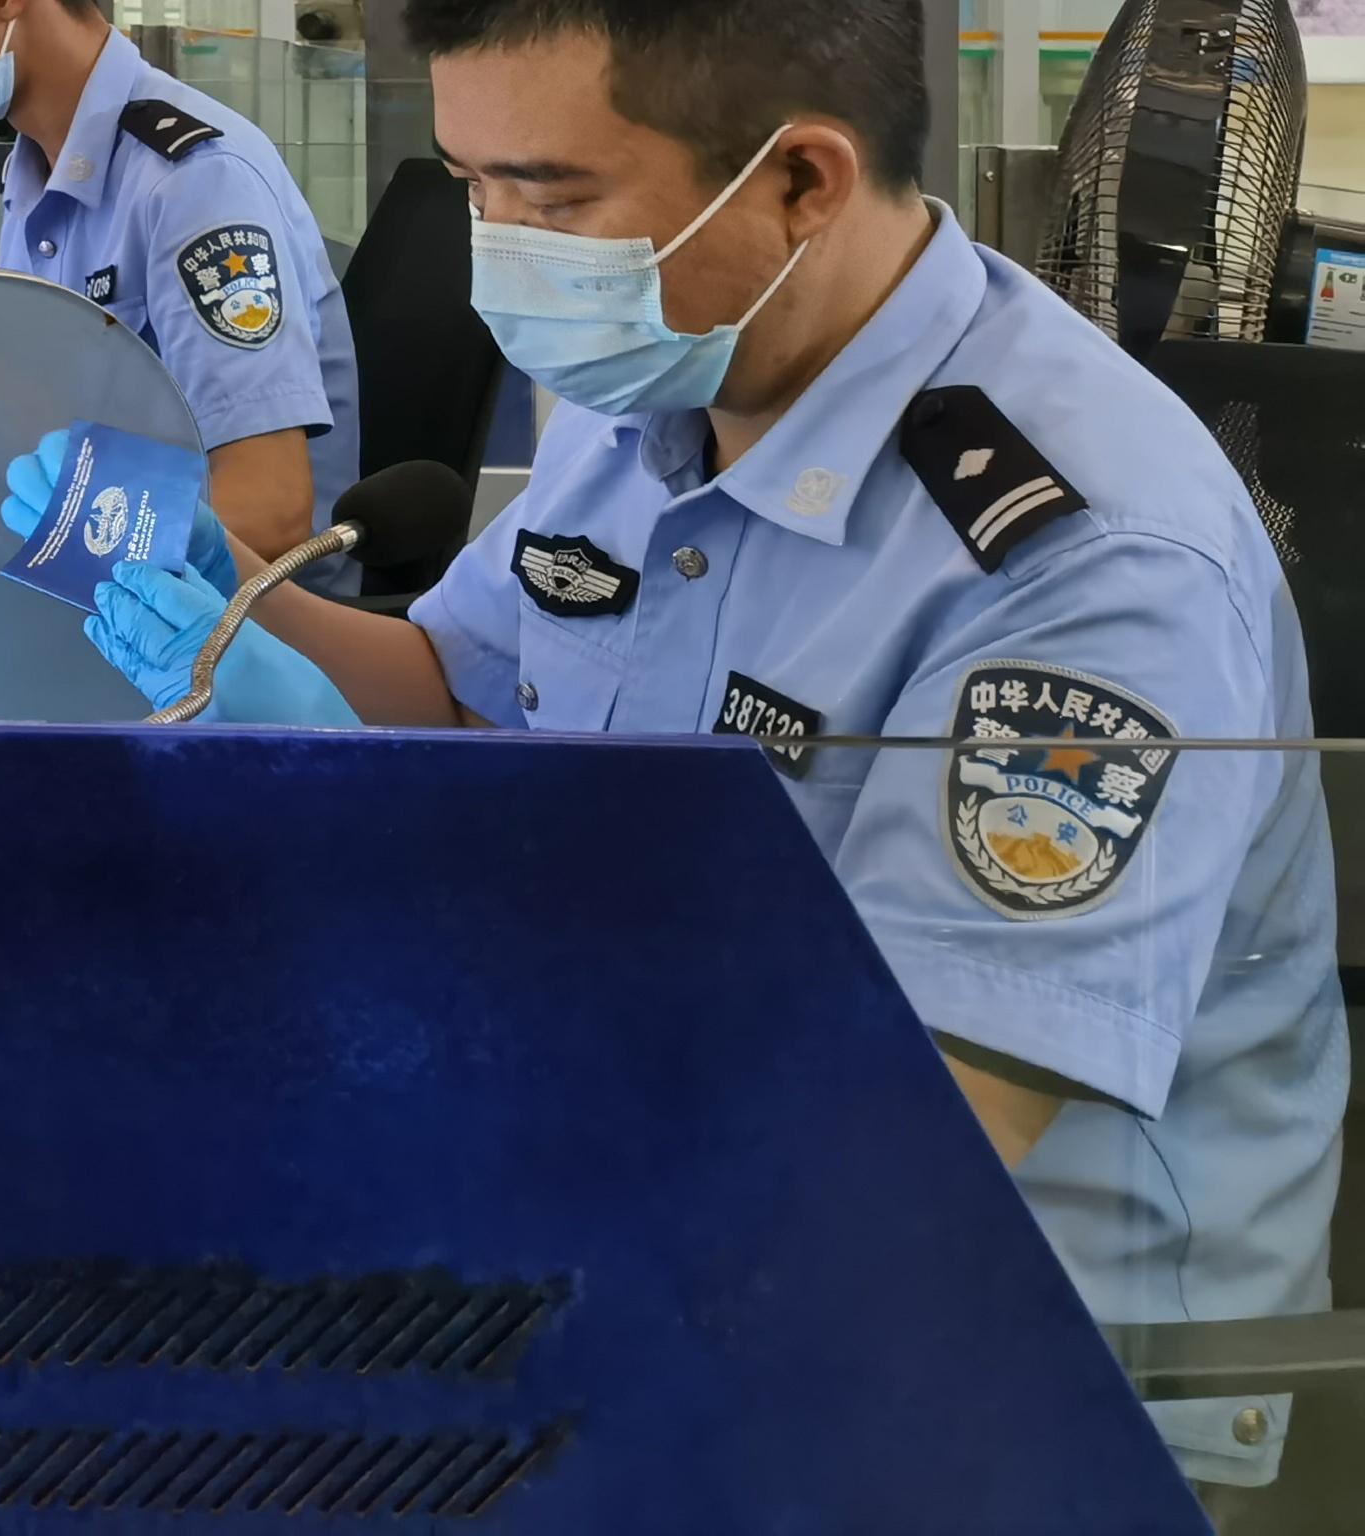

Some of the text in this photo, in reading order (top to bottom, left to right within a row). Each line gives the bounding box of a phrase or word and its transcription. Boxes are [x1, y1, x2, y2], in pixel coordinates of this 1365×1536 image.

[183, 229, 269, 272] 中华人民共和国
[222, 277, 260, 296] POLICE
[970, 679, 1171, 776] 中华人民共和国
[1005, 775, 1096, 820] POLICE
[1006, 803, 1079, 846] 公安
